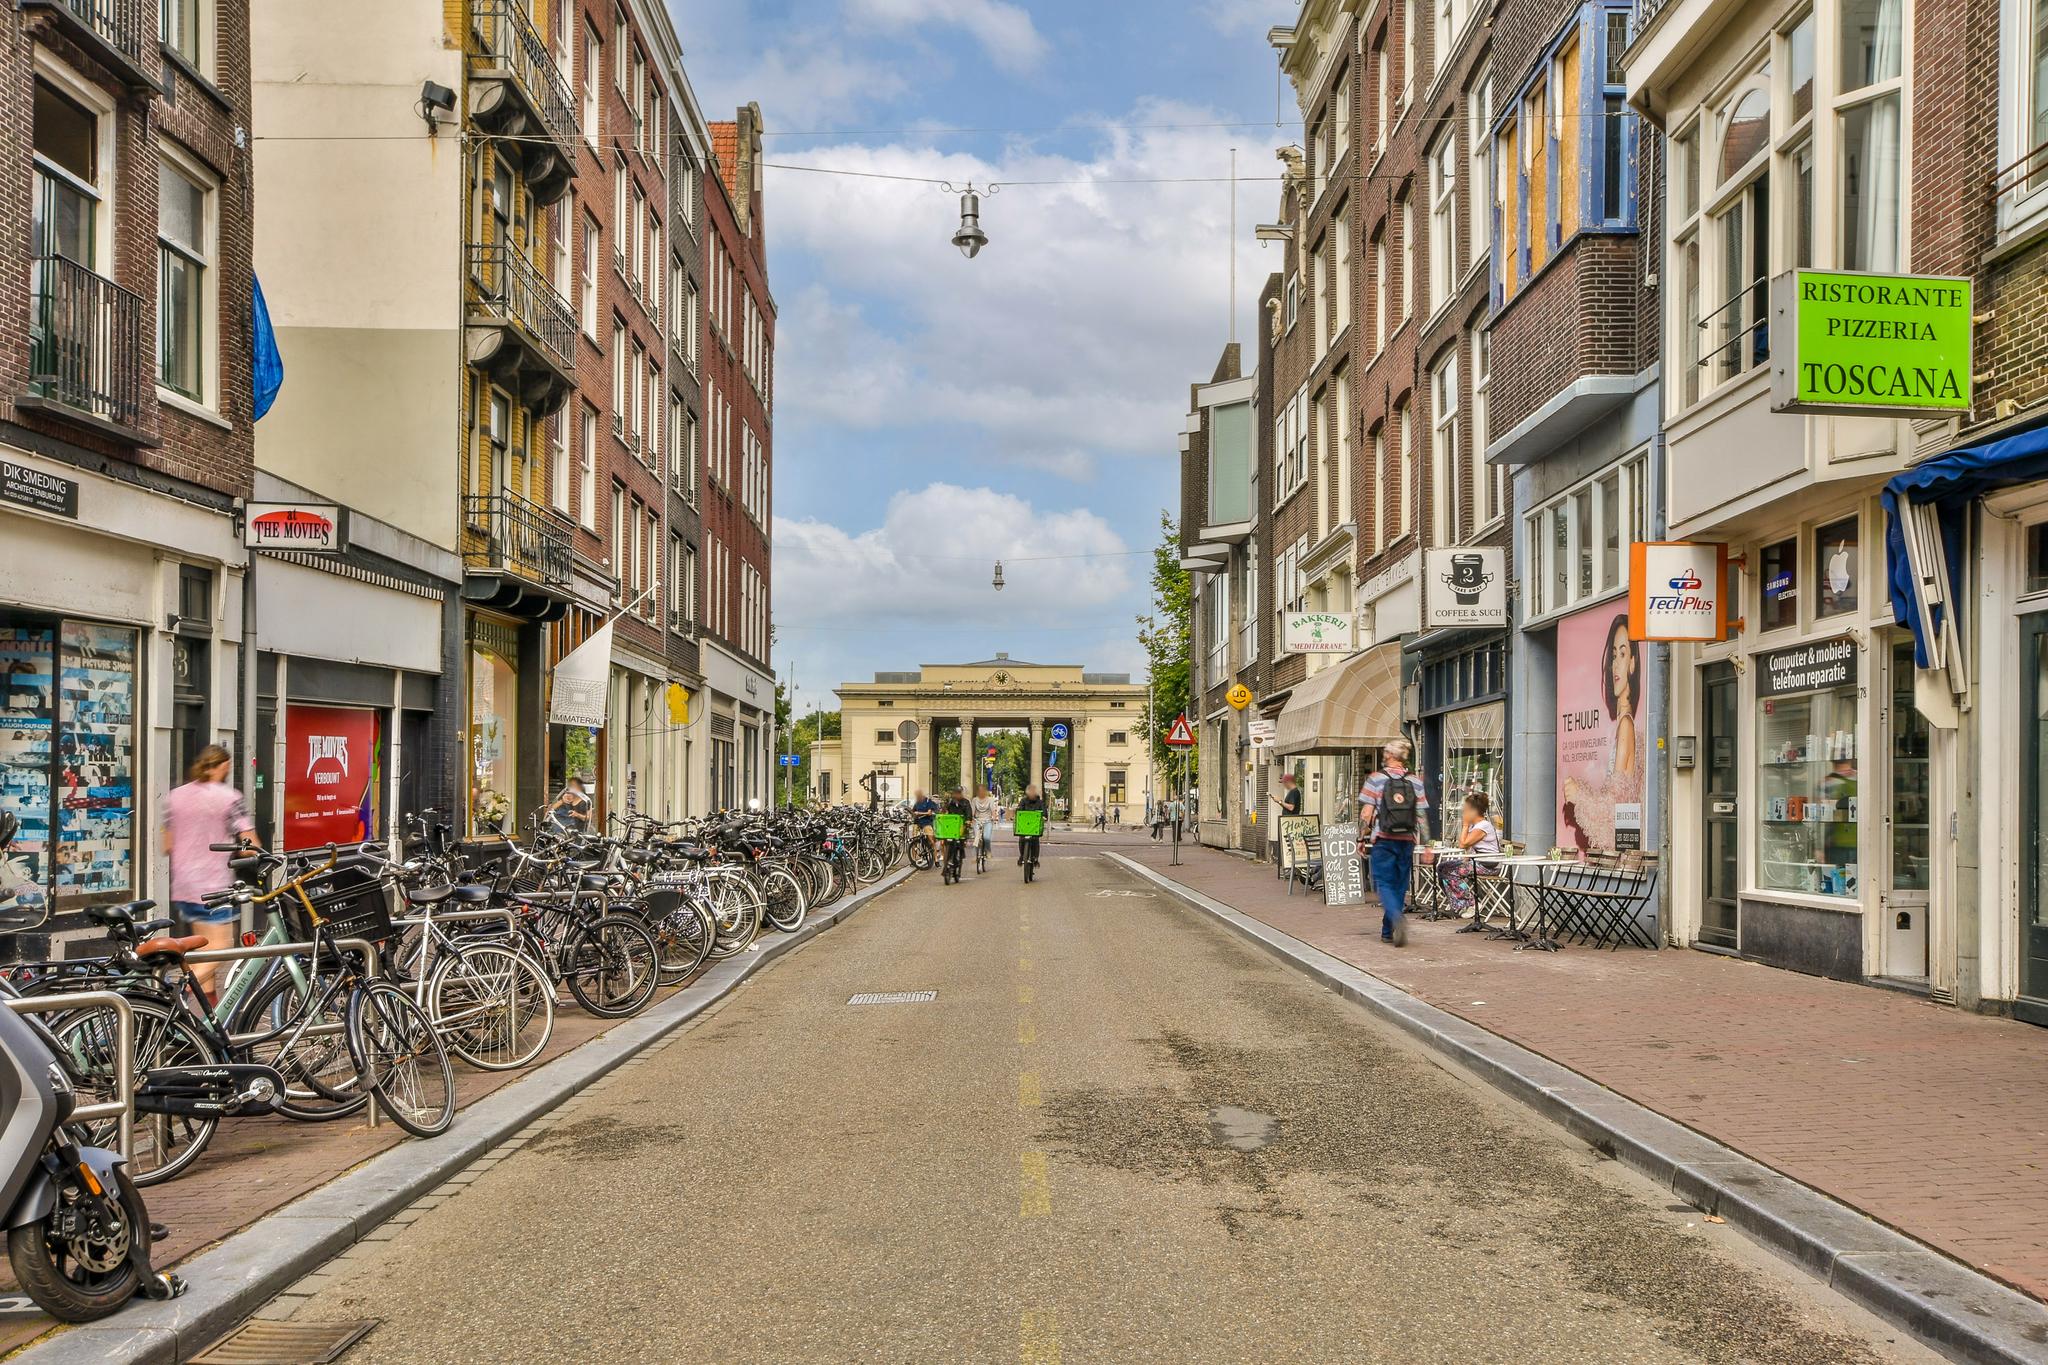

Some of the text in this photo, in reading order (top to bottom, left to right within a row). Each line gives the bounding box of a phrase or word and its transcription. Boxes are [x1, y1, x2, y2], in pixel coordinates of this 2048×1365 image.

[1803, 282, 1962, 308] RISTORANTE
[1826, 317, 1937, 341] PIZZERIA
[1804, 362, 1962, 398] TOSCANA
[3, 463, 67, 494] DIK SMEDING
[57, 495, 64, 503] BV
[287, 508, 297, 521] at
[255, 521, 329, 546] THE MOVIES
[1766, 577, 1789, 591] SAMSUNG
[1435, 608, 1502, 618] COFFEE & SUCH
[1648, 596, 1714, 611] TechPlus
[1291, 614, 1348, 631] BAKKERIJ
[81, 658, 112, 670] PICTURE
[1769, 640, 1851, 673] Computer & mobiele
[1772, 662, 1846, 690] telefoon reparatie
[1562, 709, 1600, 733] TE HUUR
[1282, 817, 1312, 833] Hair
[1324, 840, 1357, 857] ICED
[1348, 858, 1362, 898] COFFEE
[223, 976, 249, 1011] CORTINA
